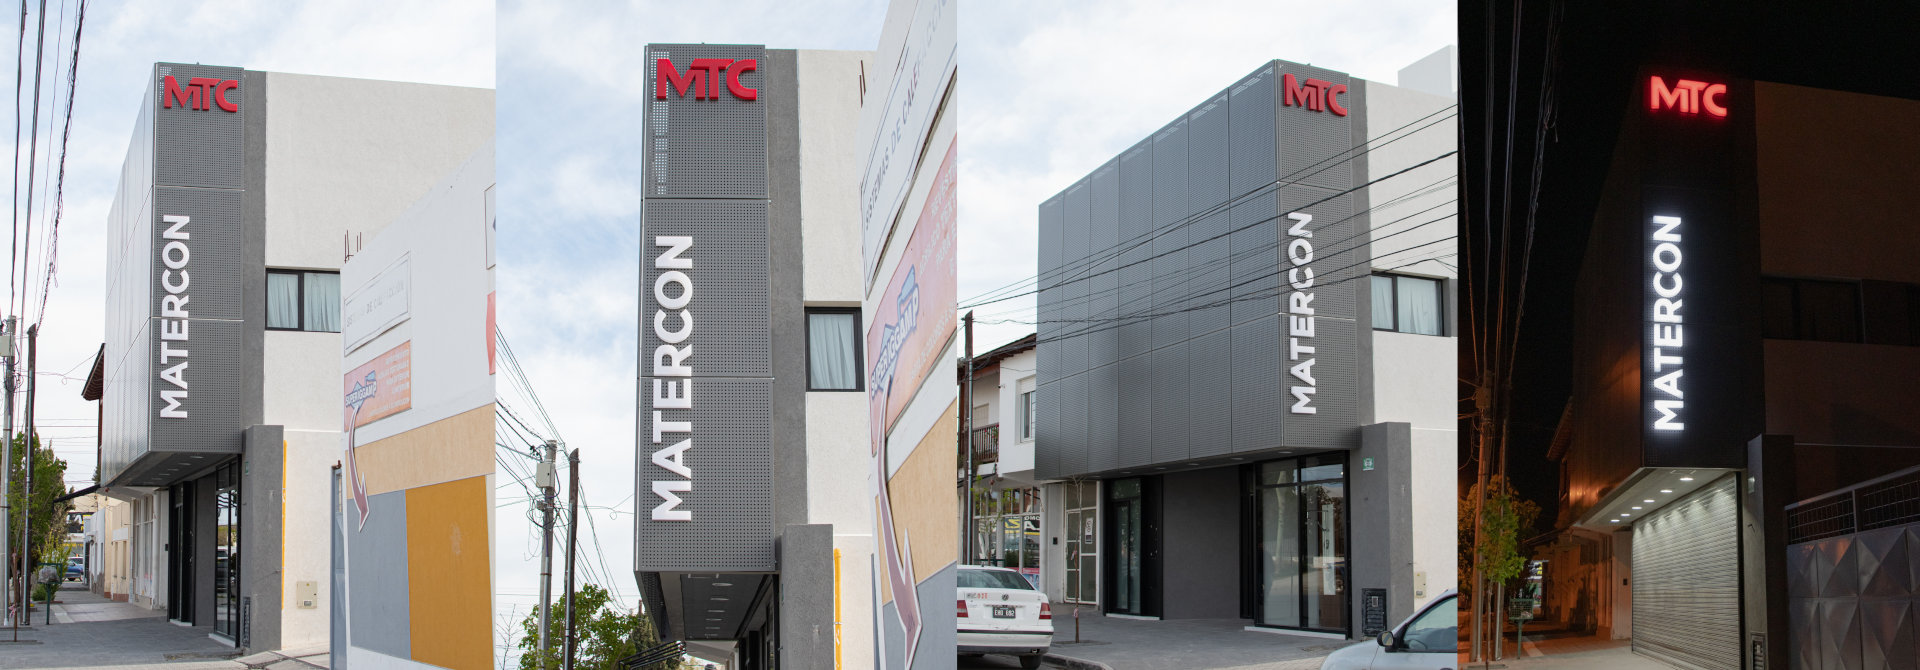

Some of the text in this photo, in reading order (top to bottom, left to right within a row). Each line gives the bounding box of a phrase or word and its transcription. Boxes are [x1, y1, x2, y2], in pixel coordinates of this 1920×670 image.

[163, 75, 239, 113] MTC
[656, 57, 757, 101] MTC
[1283, 73, 1348, 116] MTC
[1650, 75, 1728, 117] MTC
[160, 214, 190, 419] MATERCON
[1287, 211, 1317, 415] MATERCON
[1652, 214, 1685, 432] MATERCON
[651, 235, 694, 522] MATERCON
